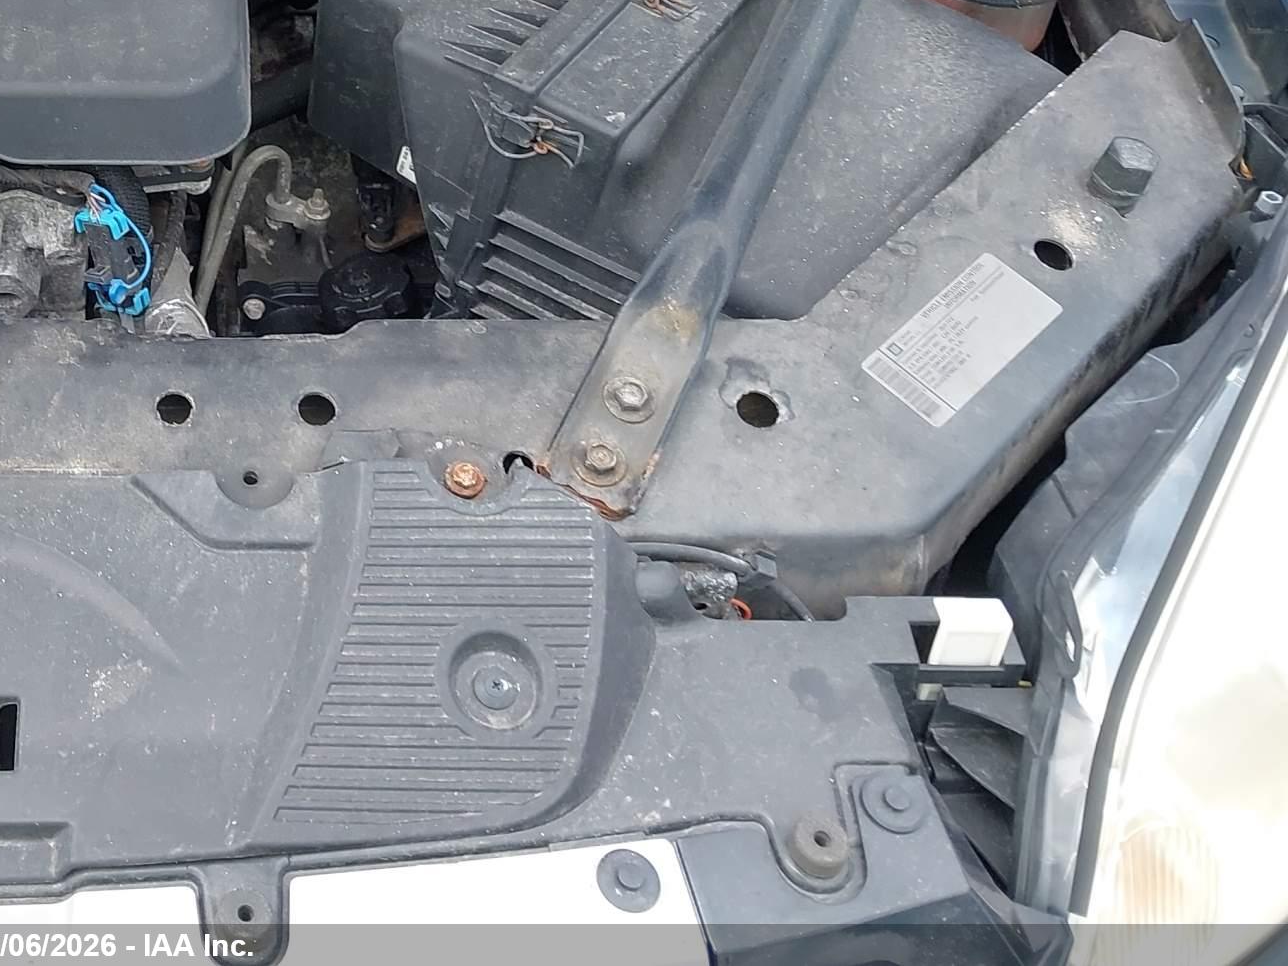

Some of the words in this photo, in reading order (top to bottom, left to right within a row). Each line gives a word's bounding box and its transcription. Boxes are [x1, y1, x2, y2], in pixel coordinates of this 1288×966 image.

[919, 299, 941, 319] VEHICLE
[940, 279, 965, 301] EMISSION
[959, 261, 985, 282] CONTROL
[943, 278, 977, 309] INFORMATION
